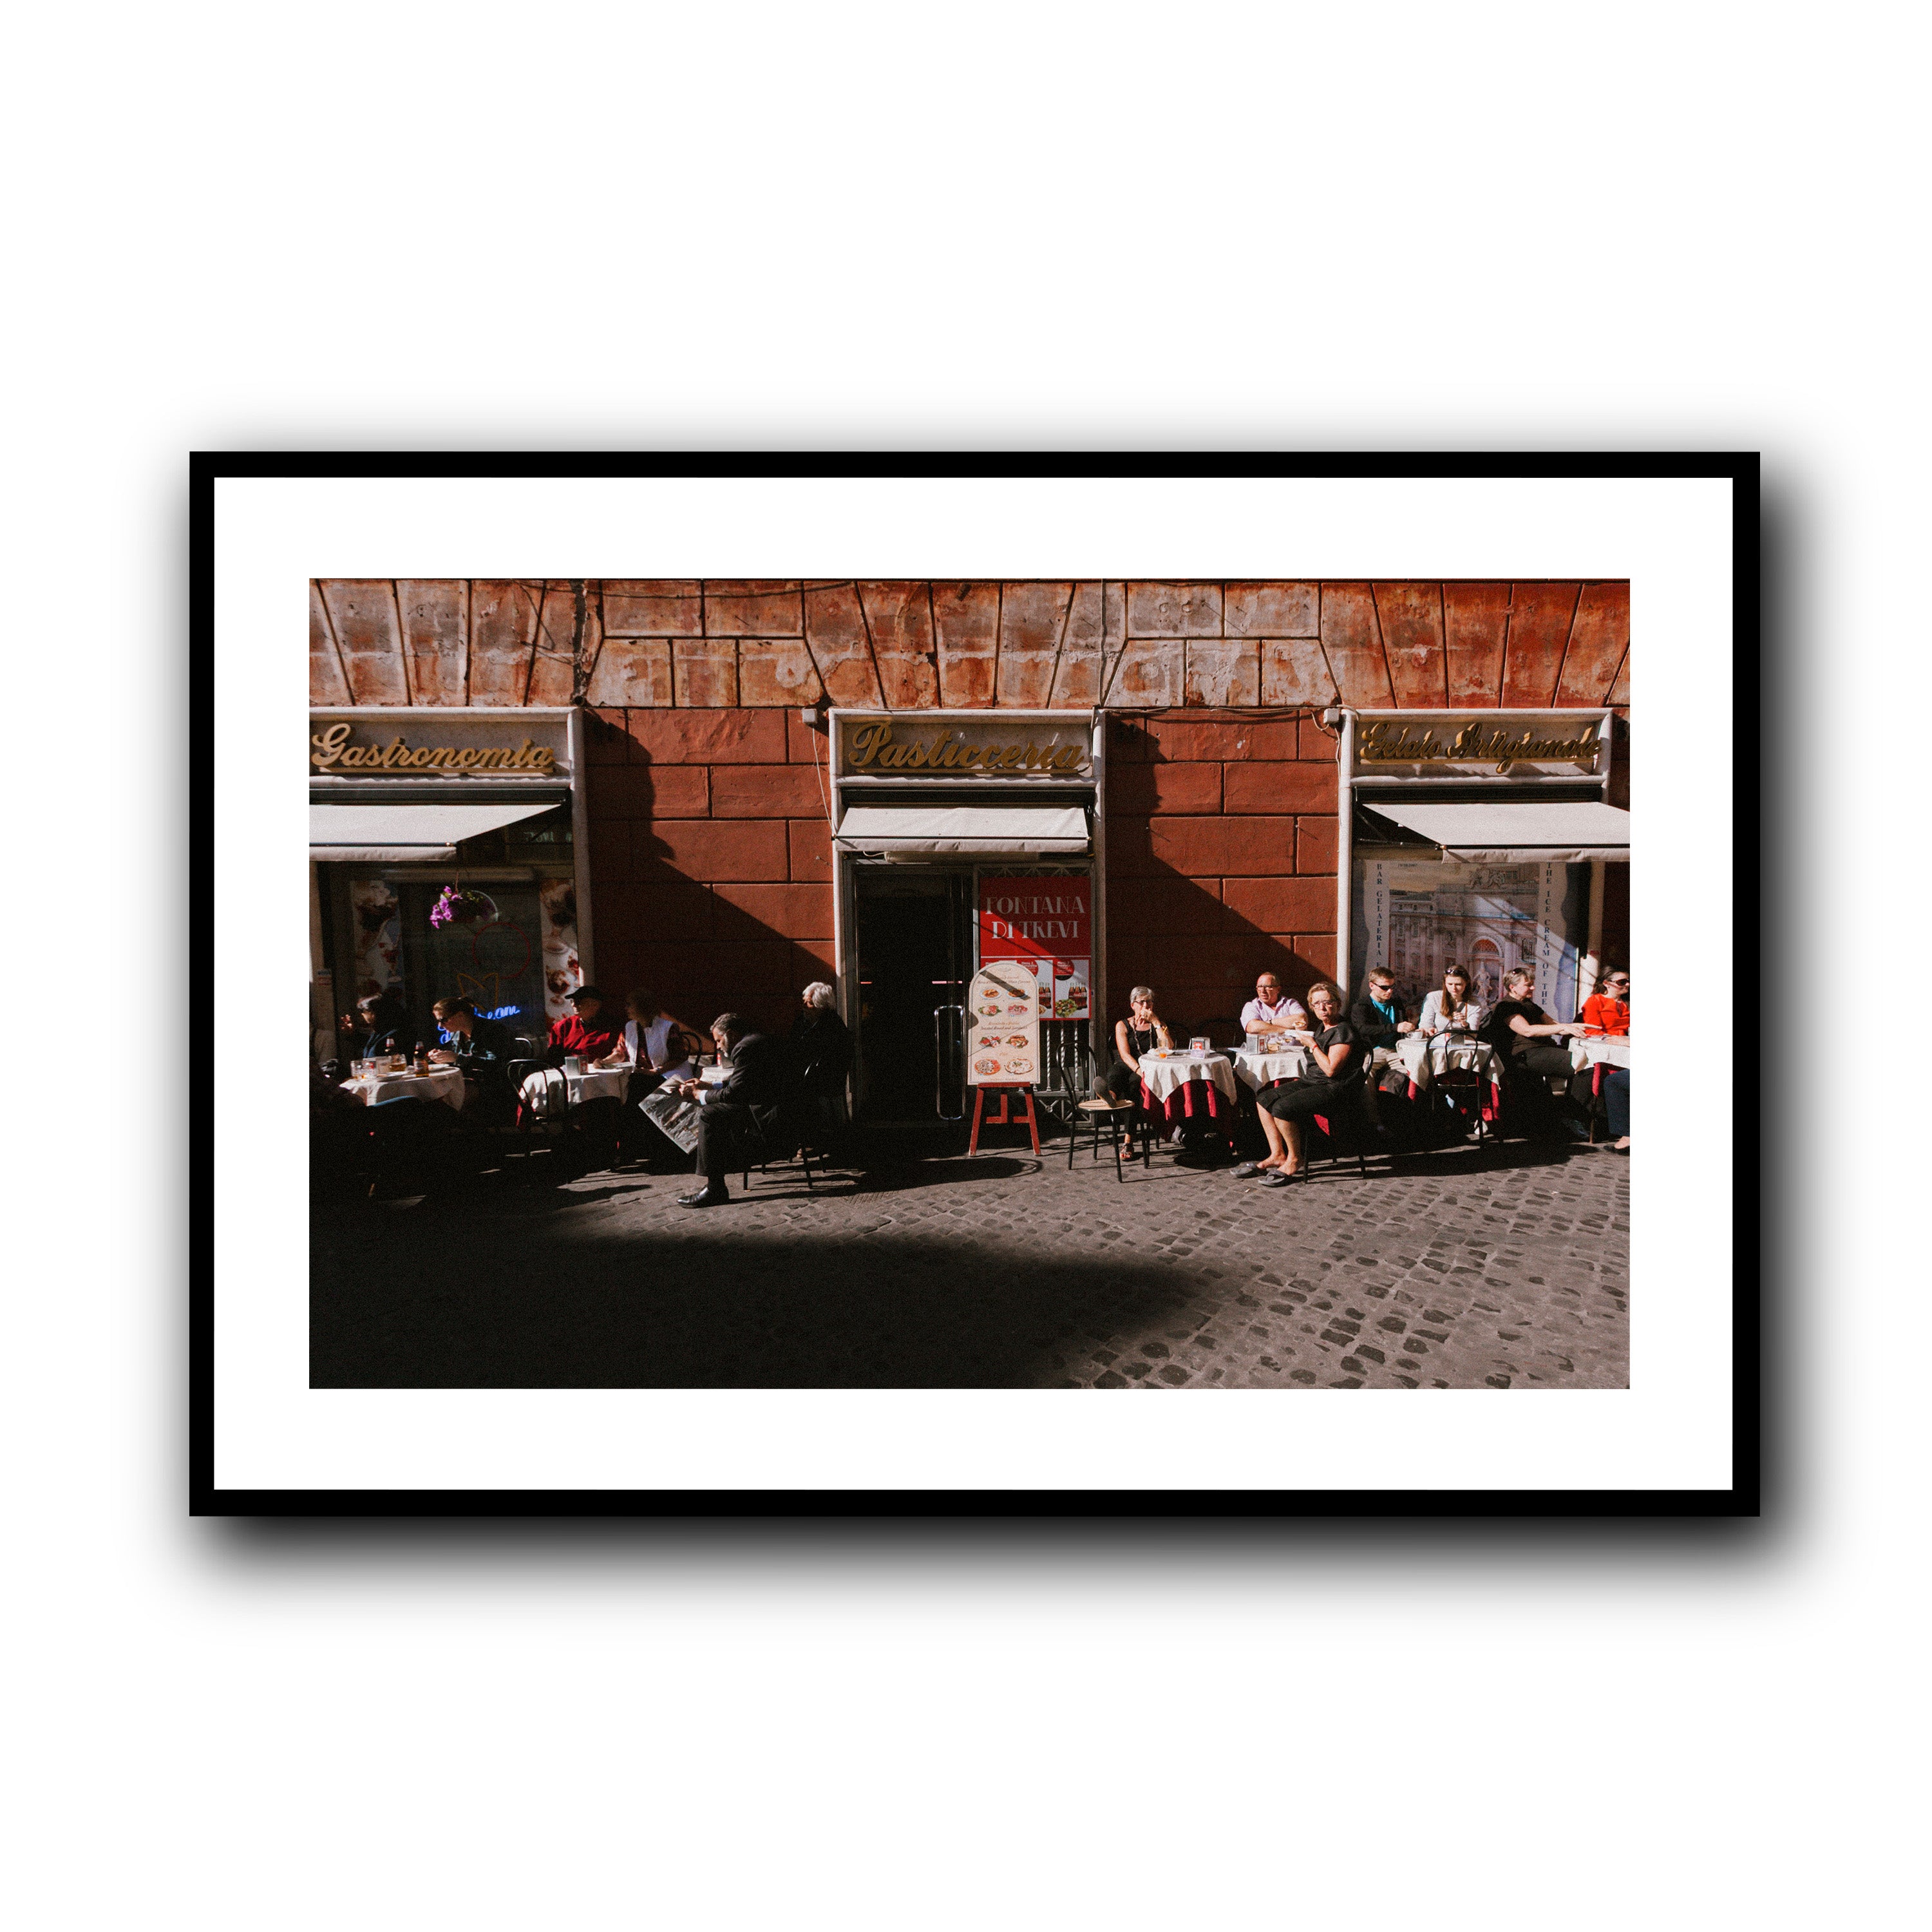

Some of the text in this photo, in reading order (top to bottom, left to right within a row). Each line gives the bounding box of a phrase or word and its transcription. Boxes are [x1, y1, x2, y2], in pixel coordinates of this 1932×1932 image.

[312, 723, 556, 767] Gastronomia
[848, 719, 1085, 768] Pasticceria
[1359, 721, 1604, 773] Gelato Artigianale
[985, 896, 1085, 914] FONTANA
[992, 920, 1079, 938] DI TREVI
[1542, 919, 1551, 956] CREAM
[1542, 963, 1549, 977] OF
